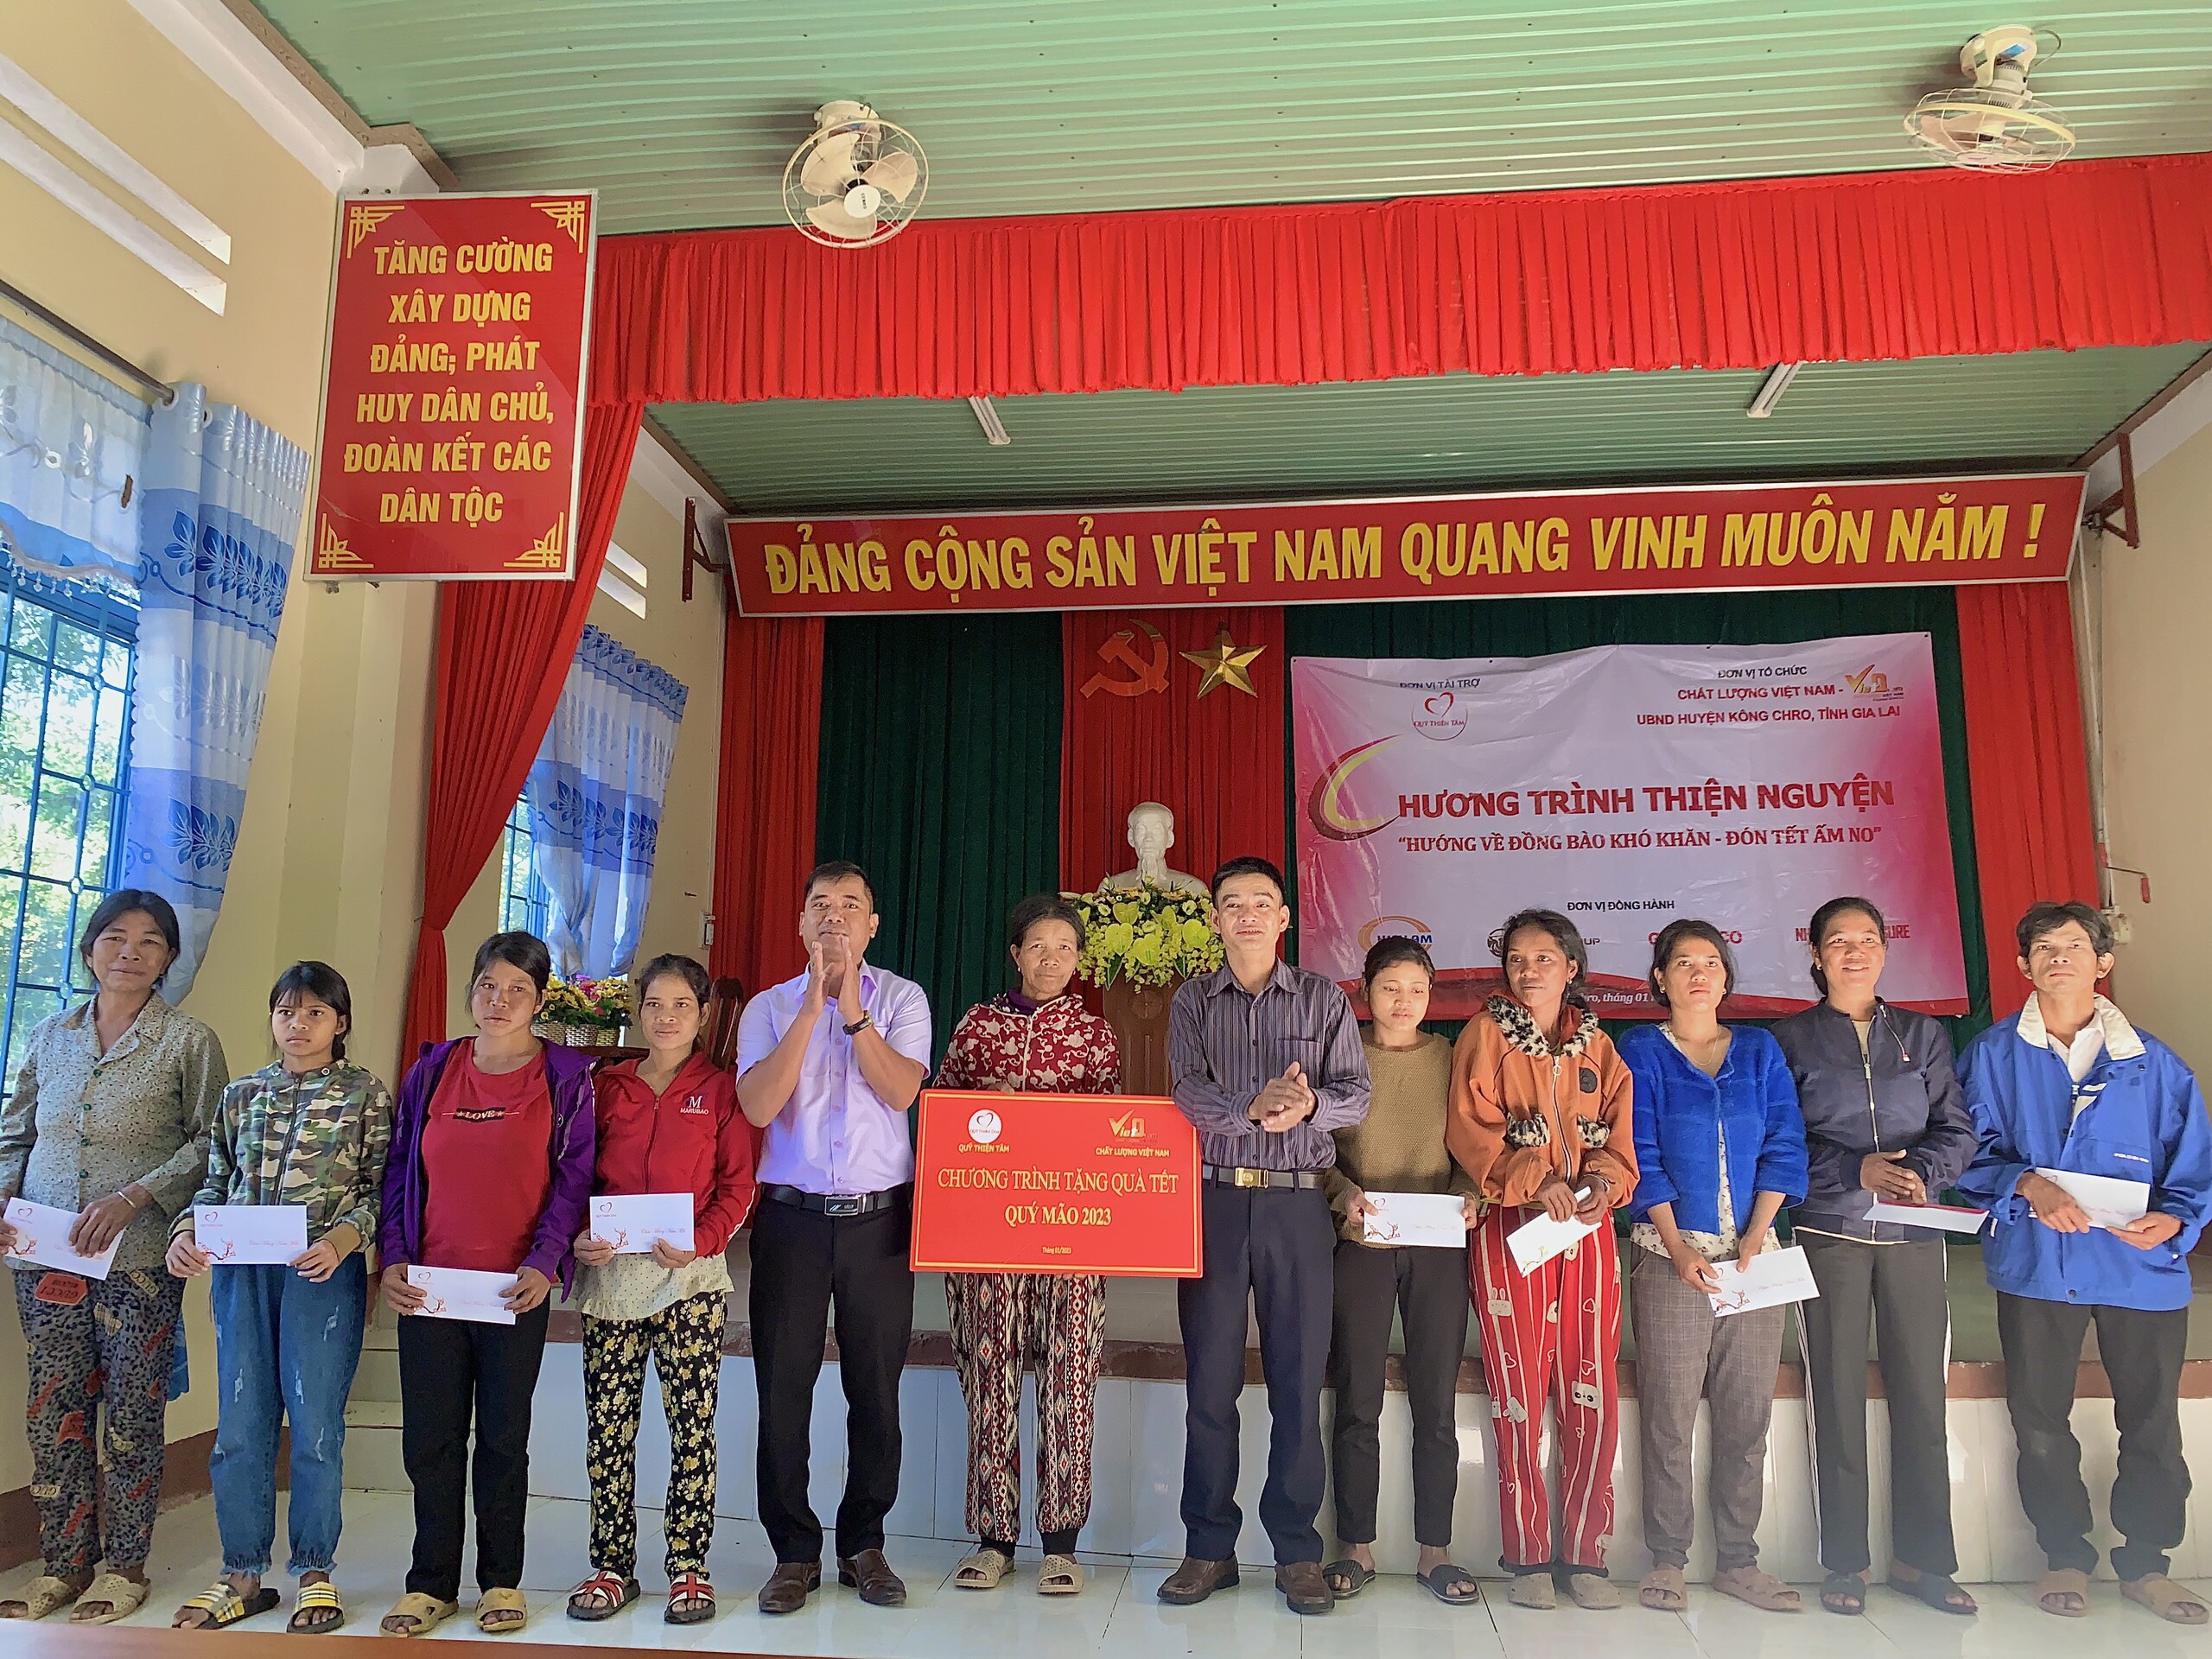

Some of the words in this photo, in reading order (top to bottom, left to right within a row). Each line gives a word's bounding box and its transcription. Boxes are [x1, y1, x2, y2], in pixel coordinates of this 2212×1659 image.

[373, 239, 447, 275] TĂNG
[456, 236, 553, 273] CƯỜNG
[388, 288, 445, 323] XÂY
[453, 290, 531, 327] DỰNG
[370, 334, 457, 376] ĐẢNG;
[466, 335, 540, 372] PHÁT
[356, 393, 414, 423] HUY
[421, 386, 480, 422] DÂN
[490, 382, 554, 423] CHỦ,
[344, 435, 423, 473] ĐOÀN
[432, 432, 486, 472] KẾT
[493, 435, 551, 472] CÁC
[379, 487, 440, 523] DÂN
[450, 485, 505, 528] TỘC
[765, 524, 890, 595] ĐẢNG
[904, 524, 1034, 603] CỘNG
[1044, 516, 1138, 589] SẢN
[1151, 518, 1258, 596] VIỆT
[1273, 526, 1382, 582] NAM
[1401, 518, 1570, 585] QUANG
[1590, 513, 1708, 571] VINH
[1720, 493, 1874, 569] MUÔN
[1885, 491, 2010, 563] NĂM
[1438, 678, 1454, 689] TÀI
[1457, 678, 1480, 689] TRỢ
[1718, 669, 1743, 678] ĐƠN
[1745, 669, 1756, 679] VỊ
[1775, 664, 1808, 677] CHỨC
[1718, 687, 1768, 701] LƯỢNG
[1771, 685, 1801, 698] VIỆT
[1804, 685, 1835, 696] NAM
[1636, 714, 1675, 725] UBND
[1678, 711, 1725, 725] HUYỆN
[1728, 709, 1769, 722] KÔNG
[1772, 709, 1815, 721] CHRO,
[1817, 707, 1848, 720] TỈNH
[1852, 708, 1876, 718] GIA
[1878, 705, 1900, 718] LAI
[1527, 782, 1635, 816] TRÌNH
[1642, 778, 1747, 817] THIỆN
[1757, 772, 1895, 812] NGUYỆN
[1479, 832, 1505, 851] VỀ
[1508, 831, 1562, 851] ĐỒNG
[1567, 830, 1605, 849] BÀO
[1610, 827, 1651, 848] KHÓ
[1656, 829, 1711, 848] KHĂN
[1726, 827, 1767, 845] ĐÓN
[1771, 825, 1808, 844] TẾT
[1813, 824, 1844, 843] ẤM
[1567, 901, 1592, 911] ĐƠN
[1594, 901, 1605, 912] VỊ
[1643, 899, 1675, 910] HÀNH
[1603, 993, 1633, 1004] tháng
[1636, 993, 1649, 1001] 01
[465, 1110, 495, 1120] LOVE
[689, 1096, 702, 1109] M
[995, 1143, 1009, 1153] TÂM
[938, 1166, 1008, 1189] CHƯƠNG
[1011, 1166, 1060, 1190] TRÌNH
[1064, 1167, 1108, 1194] TẶNG
[1111, 1168, 1146, 1196] QUÀ
[1149, 1169, 1179, 1193] TẾT
[1005, 1201, 1039, 1227] QUÝ
[1041, 1202, 1079, 1224] MÃO
[1081, 1208, 1111, 1225] 2023
[41, 1286, 79, 1298] GUCCI
